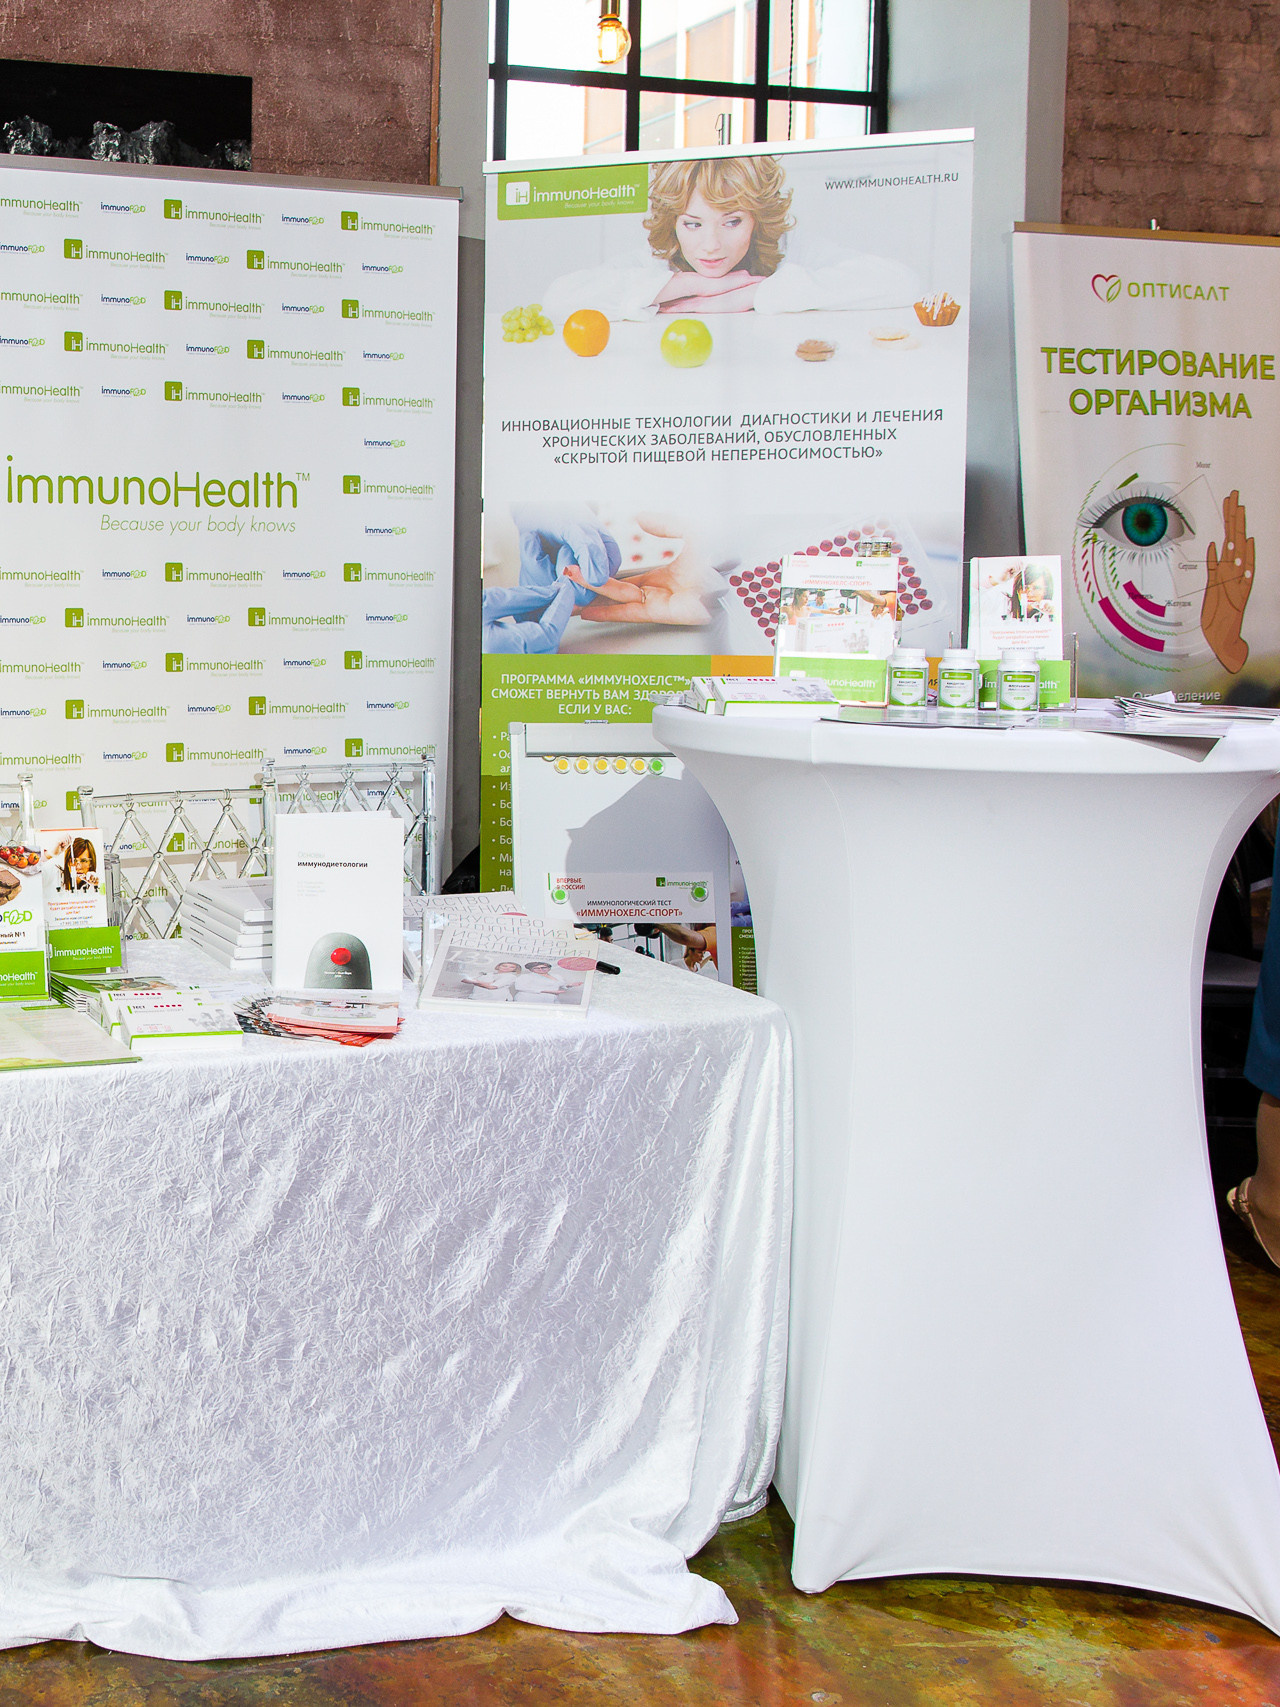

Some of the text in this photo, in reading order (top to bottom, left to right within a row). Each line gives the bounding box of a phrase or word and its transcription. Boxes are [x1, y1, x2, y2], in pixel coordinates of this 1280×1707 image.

[825, 173, 958, 190] WWW.IMMUNOHEALTH.RU
[1128, 282, 1230, 301] ОПТИСАЛТ
[1041, 347, 1275, 380] ТЕСТИРОВАНИЕ
[1069, 389, 1252, 419] ОРГАНИЗМА
[502, 409, 942, 432] ИННОВАЦИОННЫЕ ТЕХНОЛОГИИ ДИАГНОСТИКИ И ЛЕЧЕНИЯ
[543, 428, 896, 450] ХРОНИЧЕСКИХ ЗАБОЛЕВАНИЙ, ОБУСЛОВЛЕННЫХ
[554, 447, 882, 464] «СКРЫТОЙ ПИЩЕВОЙ НЕПЕРЕНОСИМОСТЬЮ»
[101, 514, 296, 536] Because your body knows
[502, 673, 575, 684] ПРОГРАММА
[492, 688, 543, 700] СМОЖЕТ
[547, 689, 600, 699] ВЕРНУТЬ
[604, 689, 629, 700] ВАМ
[558, 703, 632, 715] ЕСЛИ У ВАС:
